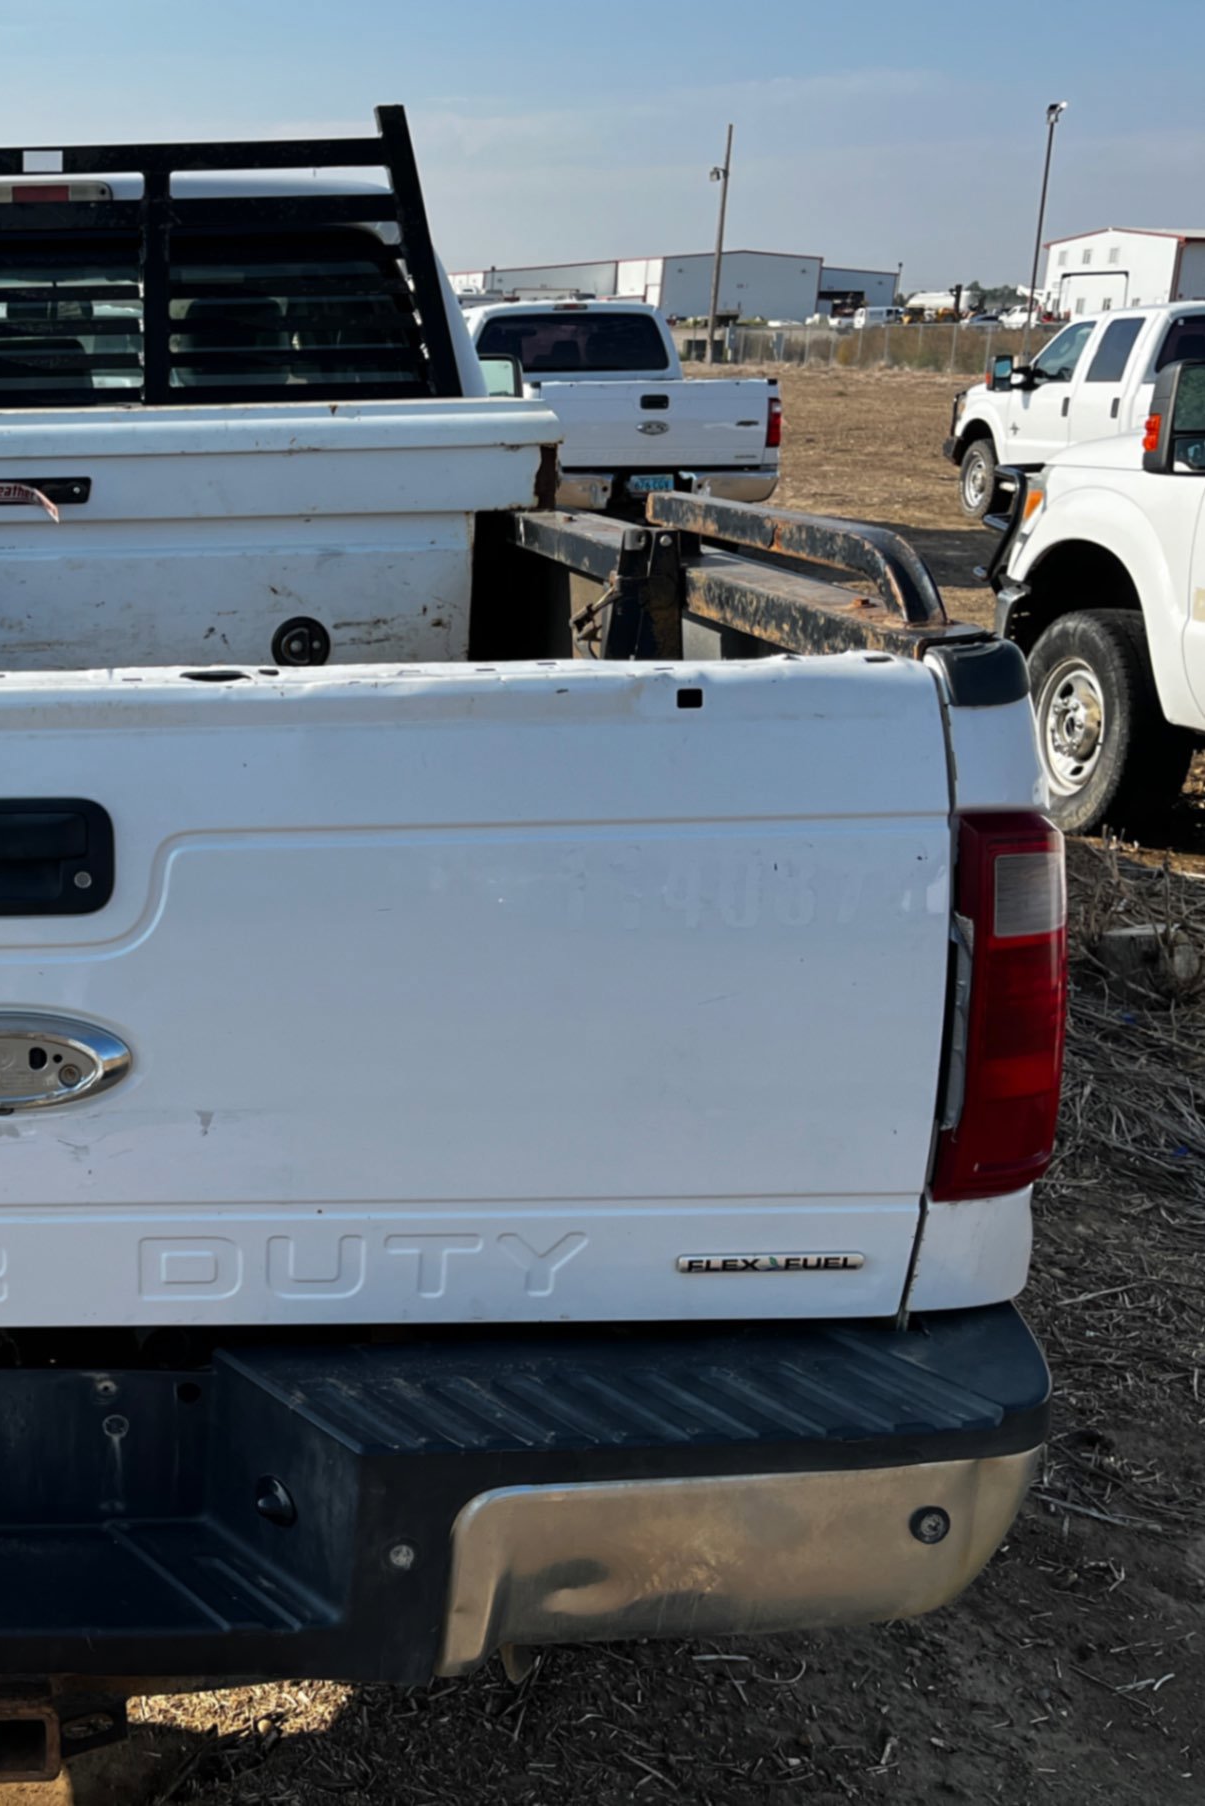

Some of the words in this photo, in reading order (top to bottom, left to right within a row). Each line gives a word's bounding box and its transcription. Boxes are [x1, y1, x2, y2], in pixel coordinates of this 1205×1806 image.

[137, 1231, 590, 1302] DUTY
[687, 1258, 760, 1273] FLEX
[784, 1256, 858, 1270] FUEL
